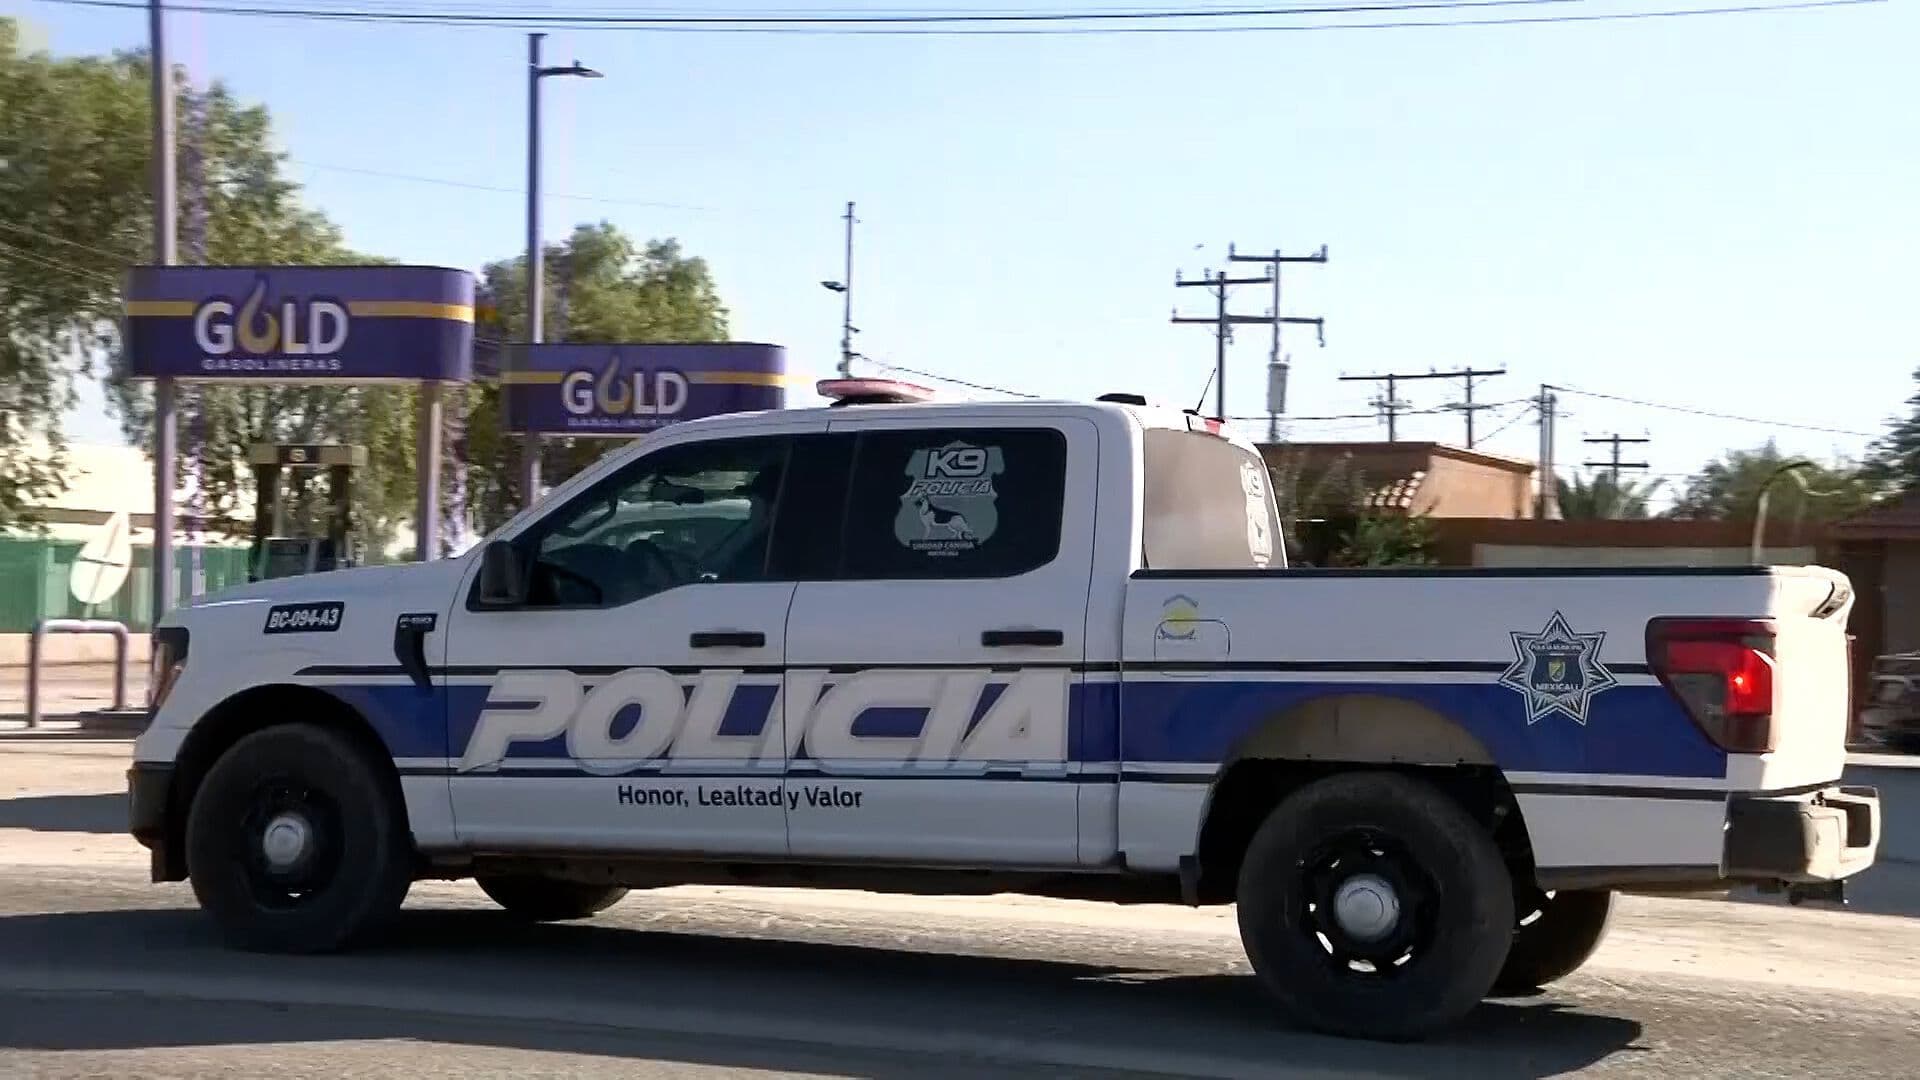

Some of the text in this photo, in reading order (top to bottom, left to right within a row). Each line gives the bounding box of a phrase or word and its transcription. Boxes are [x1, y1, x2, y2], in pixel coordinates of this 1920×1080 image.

[195, 281, 349, 355] GOLD
[561, 356, 689, 415] GOLD
[926, 449, 986, 477] K9
[269, 609, 340, 628] BC-094-A3
[457, 667, 1071, 777] POLICIA
[618, 785, 862, 810] Honor, Lealtad y Valor
